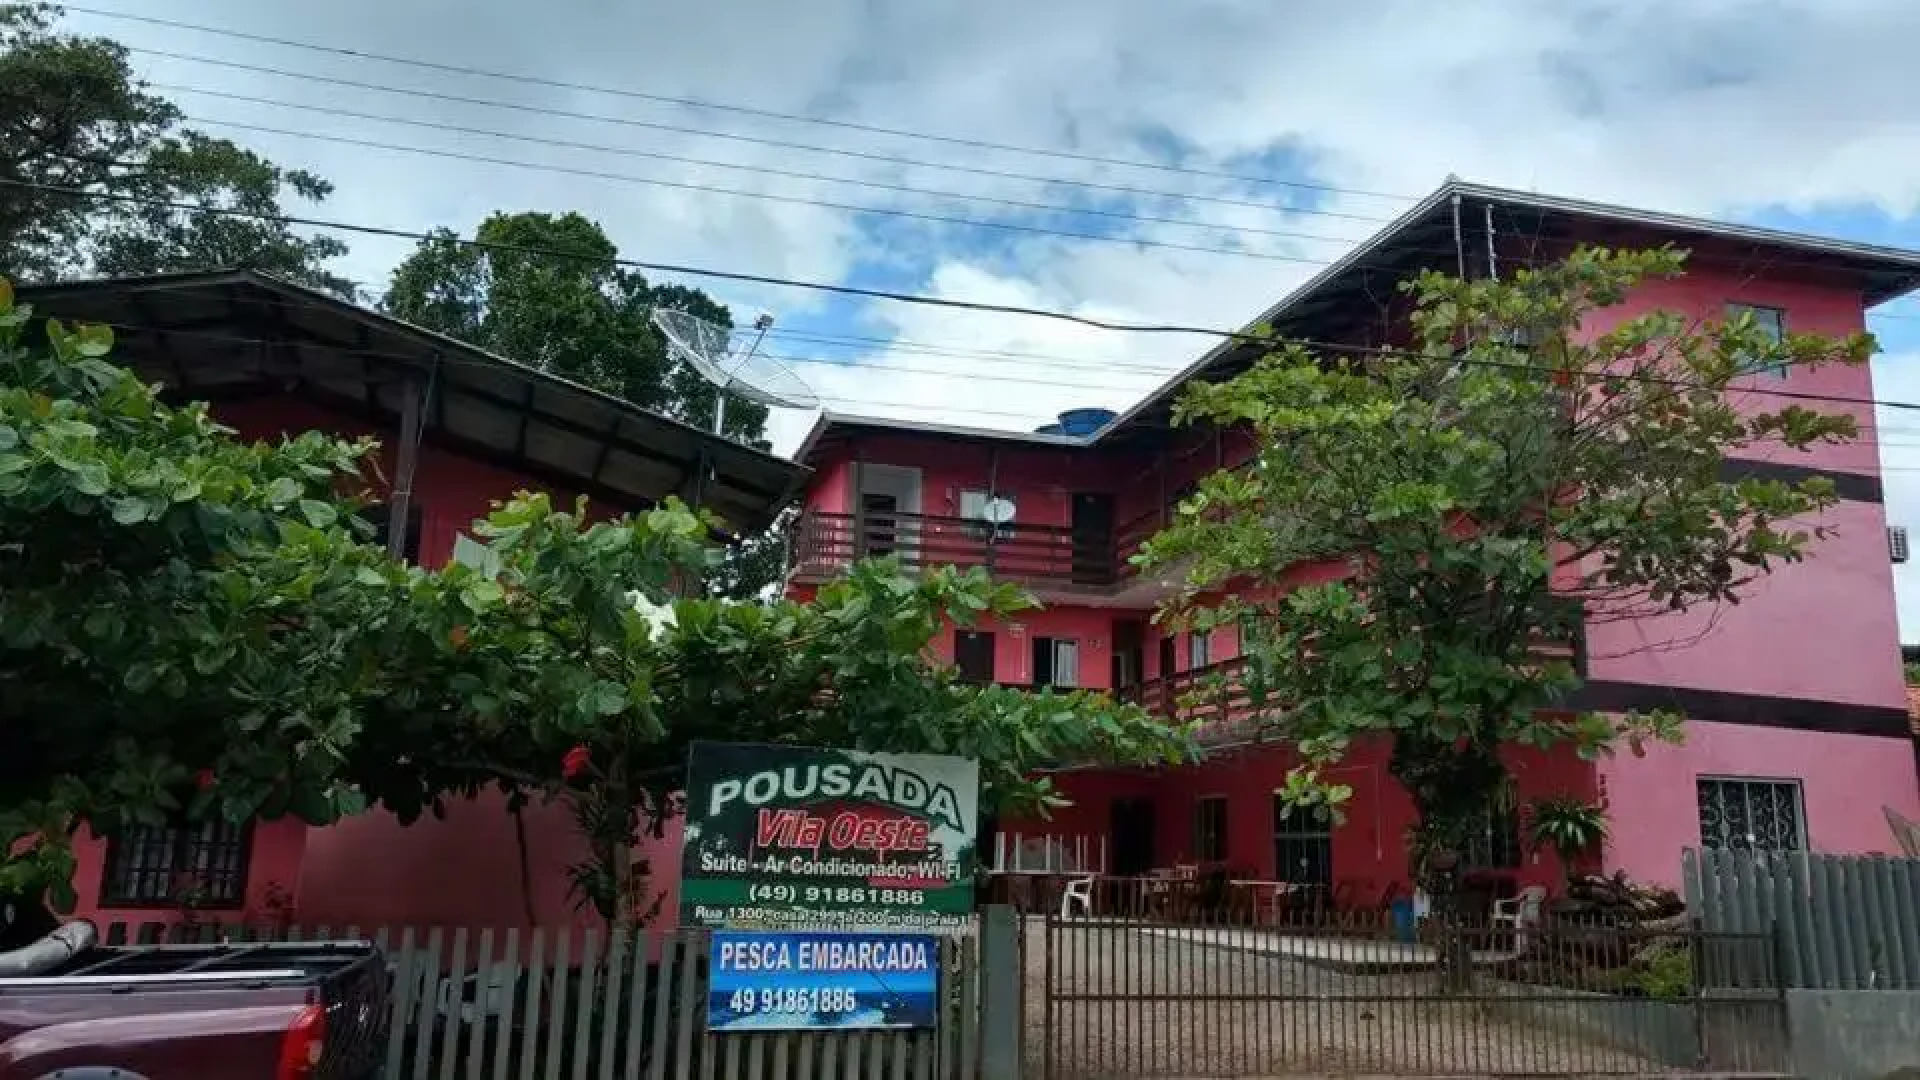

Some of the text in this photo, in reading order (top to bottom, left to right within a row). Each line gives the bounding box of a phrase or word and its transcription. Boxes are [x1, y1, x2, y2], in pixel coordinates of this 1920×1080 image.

[709, 764, 964, 834] POUSADA
[758, 807, 931, 850] Vila Oeste
[701, 852, 747, 872] Suite
[764, 855, 785, 873] Ar
[749, 883, 924, 905] (49) 91861886
[695, 905, 723, 919] Rua
[719, 941, 928, 971] PESCA EMBARCADA
[730, 988, 856, 1013] 49 91861886
